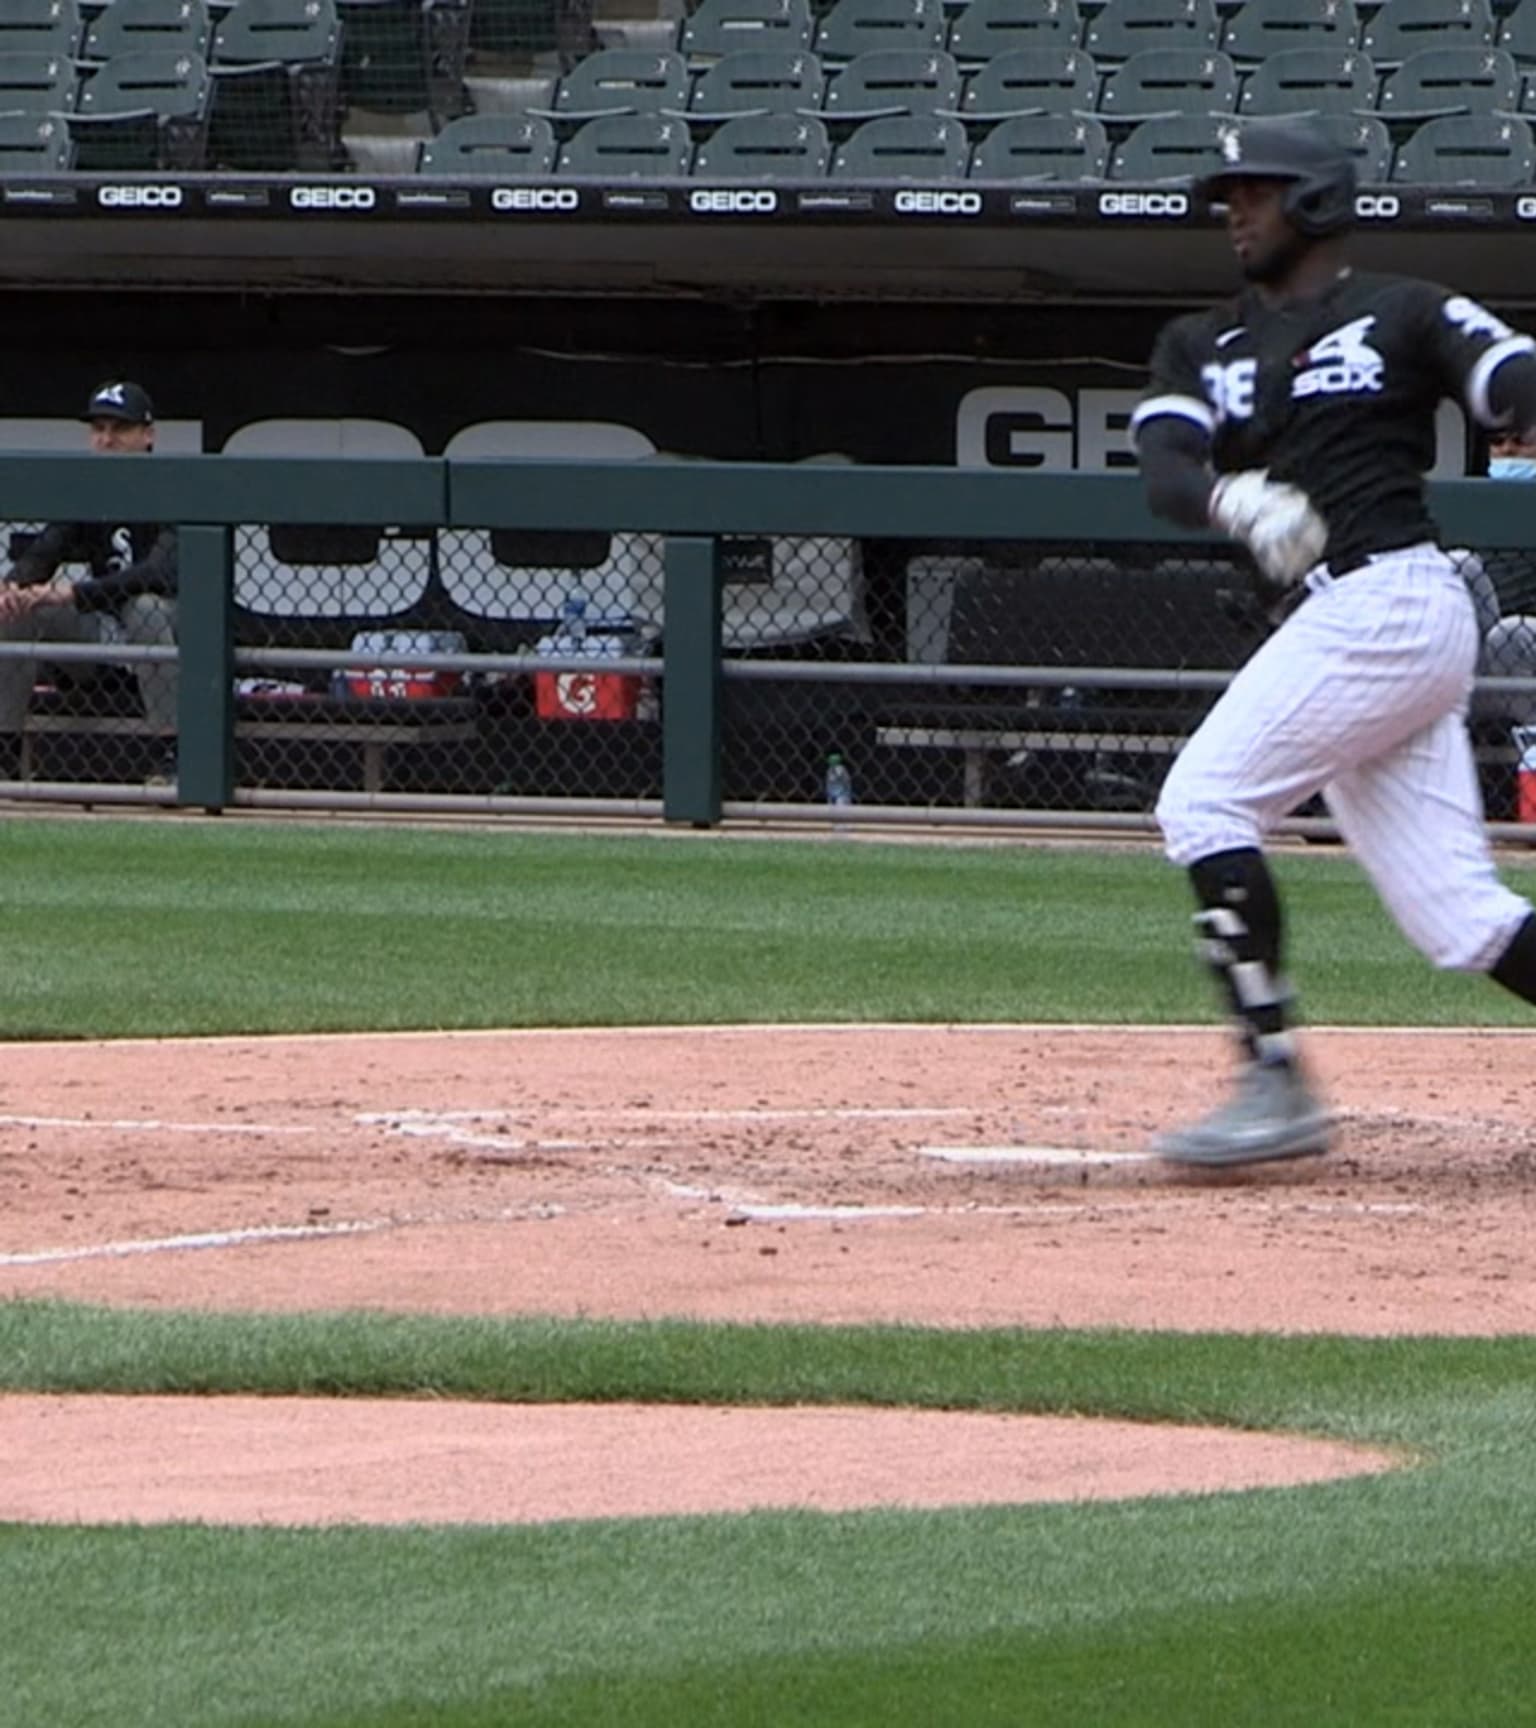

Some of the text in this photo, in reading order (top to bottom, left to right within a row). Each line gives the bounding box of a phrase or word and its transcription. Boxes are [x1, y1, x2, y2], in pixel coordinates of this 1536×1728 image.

[98, 186, 182, 206] GEICO
[290, 187, 375, 208] GEICO
[492, 188, 578, 209] GEICO
[690, 191, 777, 211] GEICO
[894, 191, 981, 213] GEICO
[1099, 193, 1188, 215] GEICO
[1291, 365, 1385, 397] SOX
